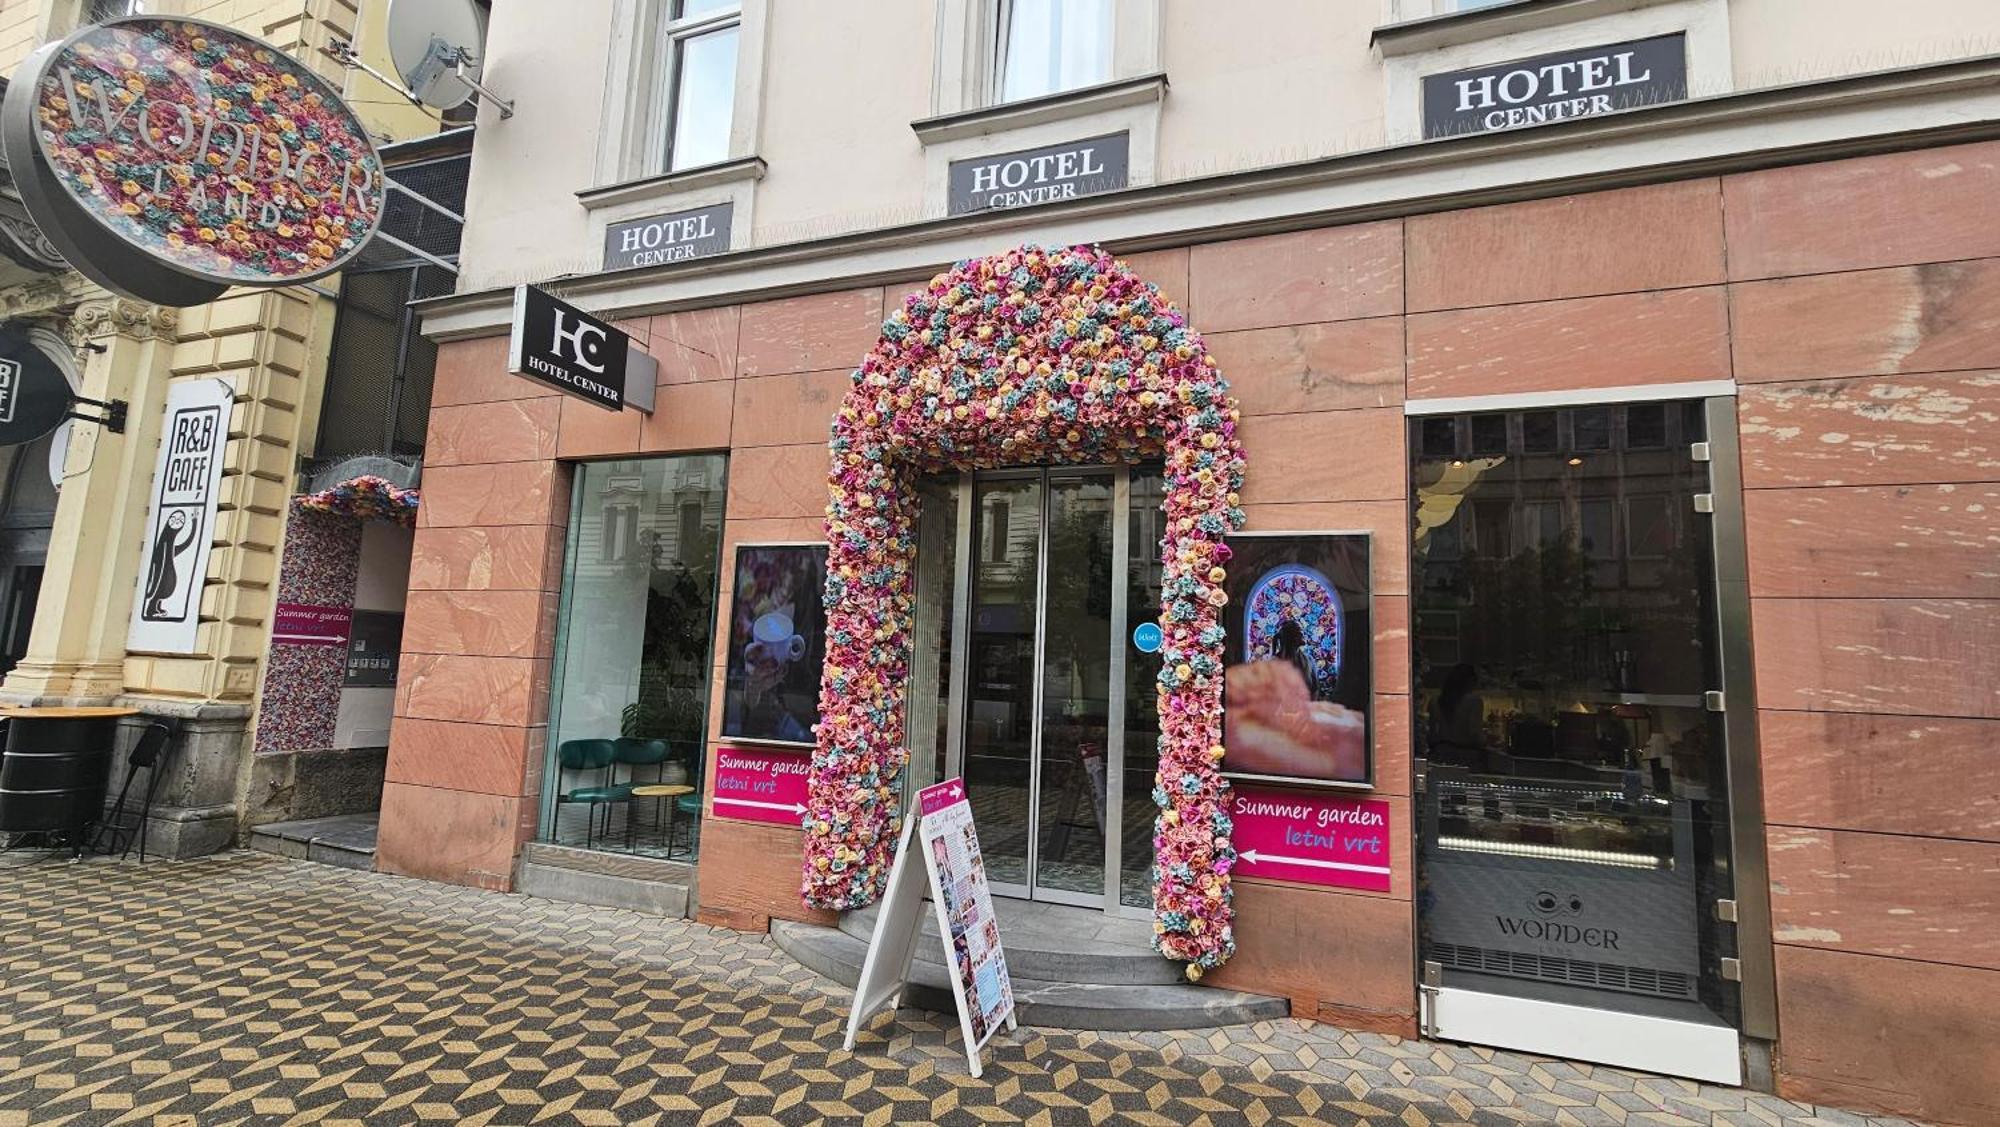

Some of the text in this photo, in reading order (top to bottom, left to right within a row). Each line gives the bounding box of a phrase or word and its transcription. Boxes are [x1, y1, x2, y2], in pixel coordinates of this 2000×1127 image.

[1455, 51, 1650, 112] HOTEL
[1484, 94, 1613, 130] CENTER
[970, 148, 1104, 193] HOTEL
[153, 167, 281, 228] LAND
[990, 183, 1076, 209] CENTER
[620, 215, 715, 252] HOTEL
[632, 244, 695, 266] CENTER
[528, 355, 619, 402] HOTEL CENTER
[175, 415, 213, 454] R&B
[277, 608, 349, 622] Summer garden
[719, 754, 769, 772] Summer
[718, 772, 777, 794] letni vrt
[1235, 797, 1384, 828] Summer garden
[1286, 825, 1381, 854] letni vrt
[1496, 915, 1619, 950] WONDER
